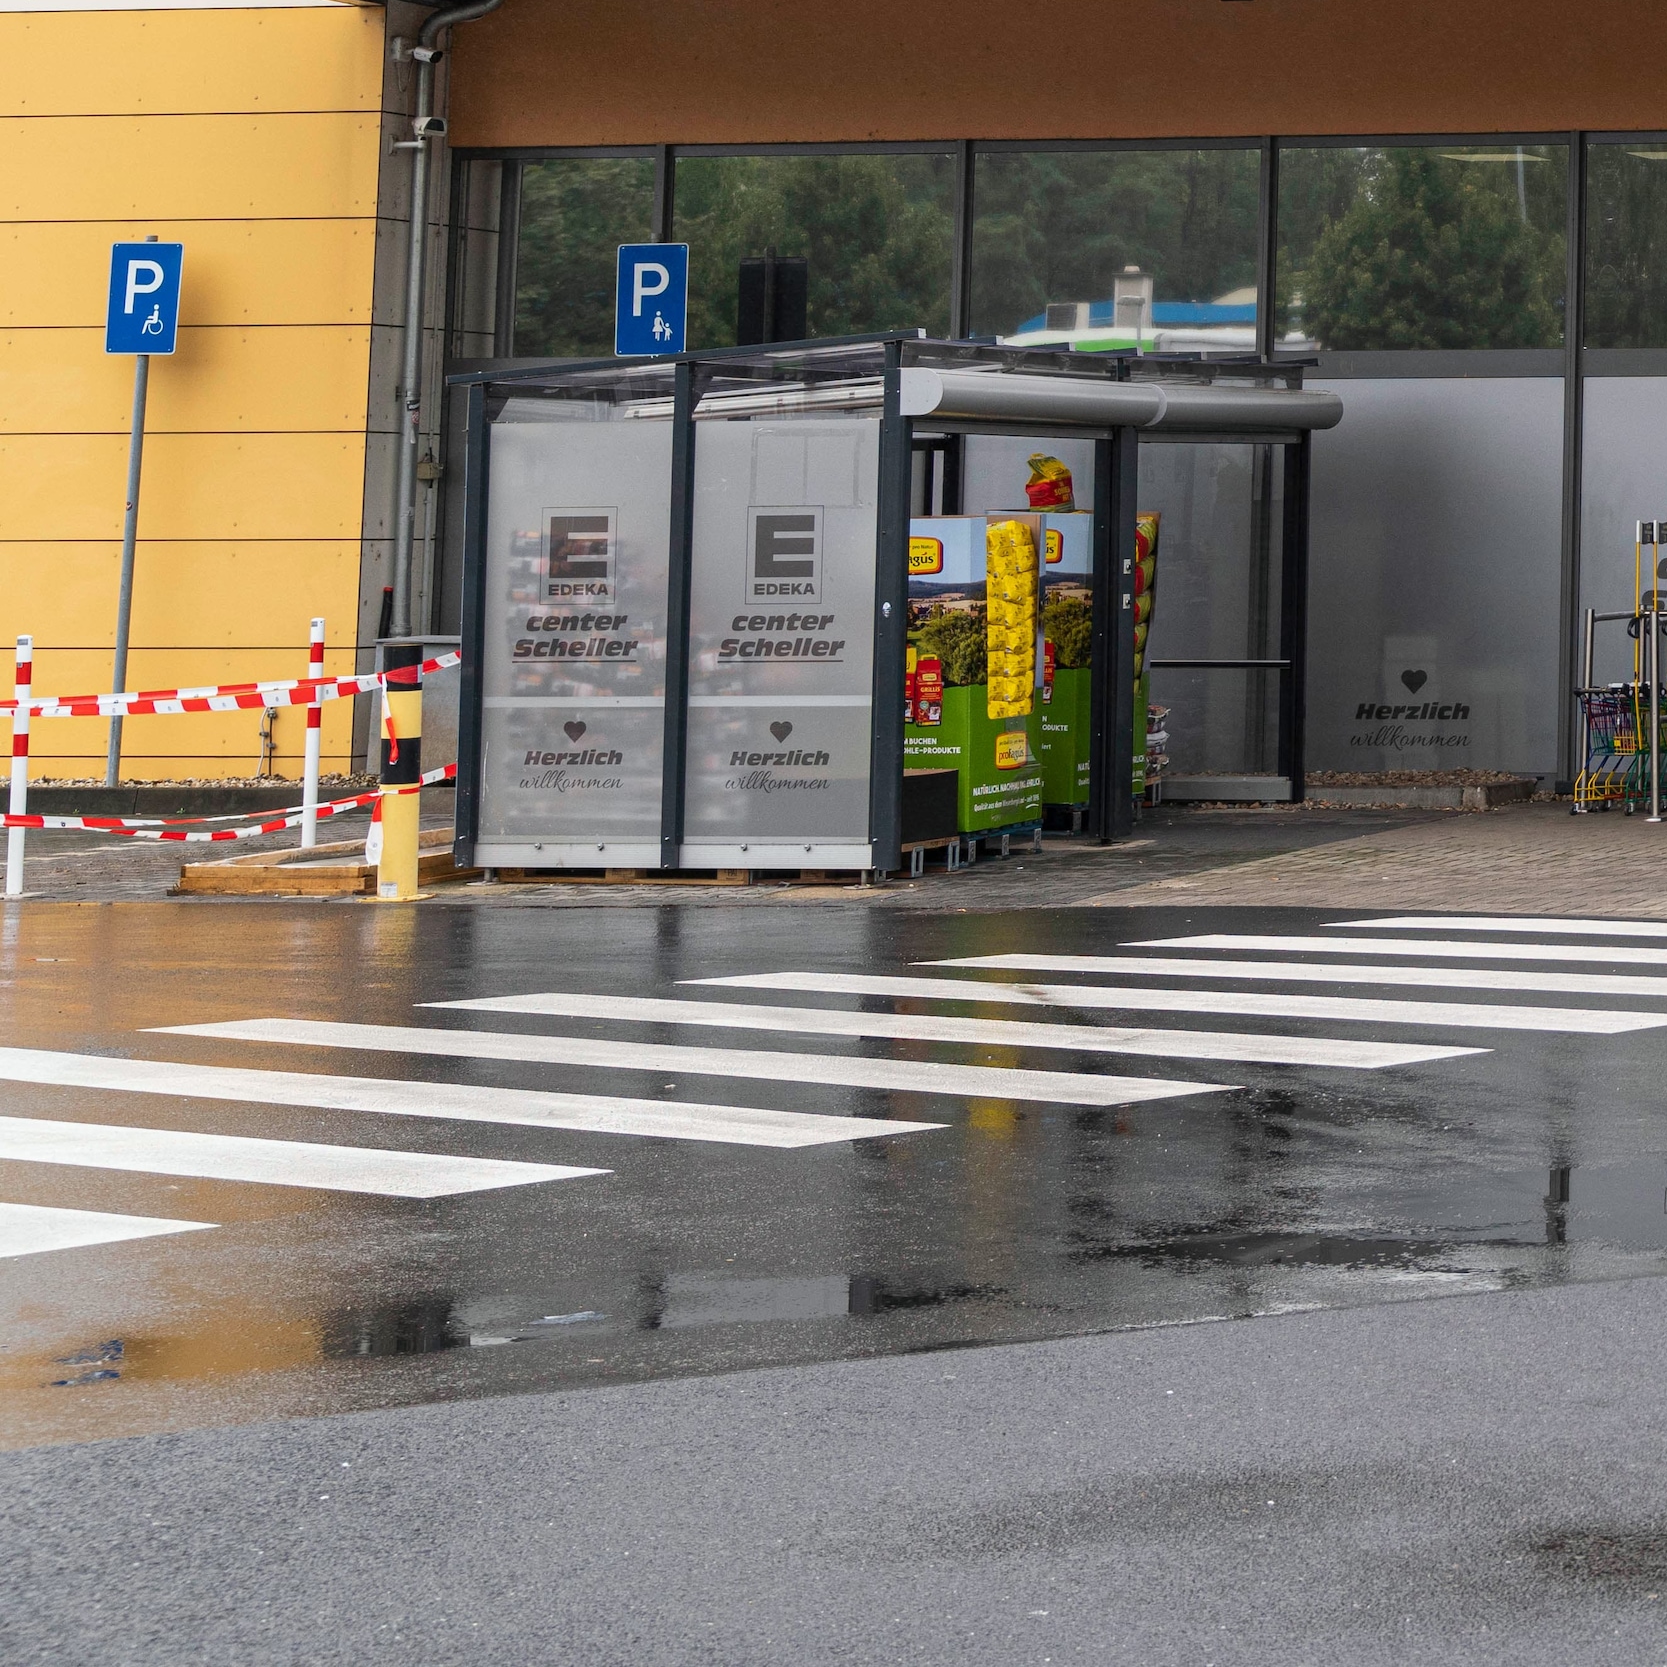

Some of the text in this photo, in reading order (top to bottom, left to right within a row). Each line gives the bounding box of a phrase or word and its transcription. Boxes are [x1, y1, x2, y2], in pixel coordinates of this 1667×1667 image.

[124, 259, 165, 314] P
[632, 262, 670, 317] P
[548, 583, 609, 597] EDEKA
[753, 582, 815, 596] EDEKA
[525, 613, 628, 632] center
[730, 613, 835, 632] center
[512, 638, 639, 658] Scheller
[717, 637, 845, 658] Scheller
[1355, 701, 1471, 720] Herzlich
[1350, 725, 1471, 751] willkommen
[524, 750, 623, 767] Herzlich
[729, 750, 830, 767] Herzlich
[519, 769, 624, 793] willkommen
[724, 769, 830, 793] willkommen
